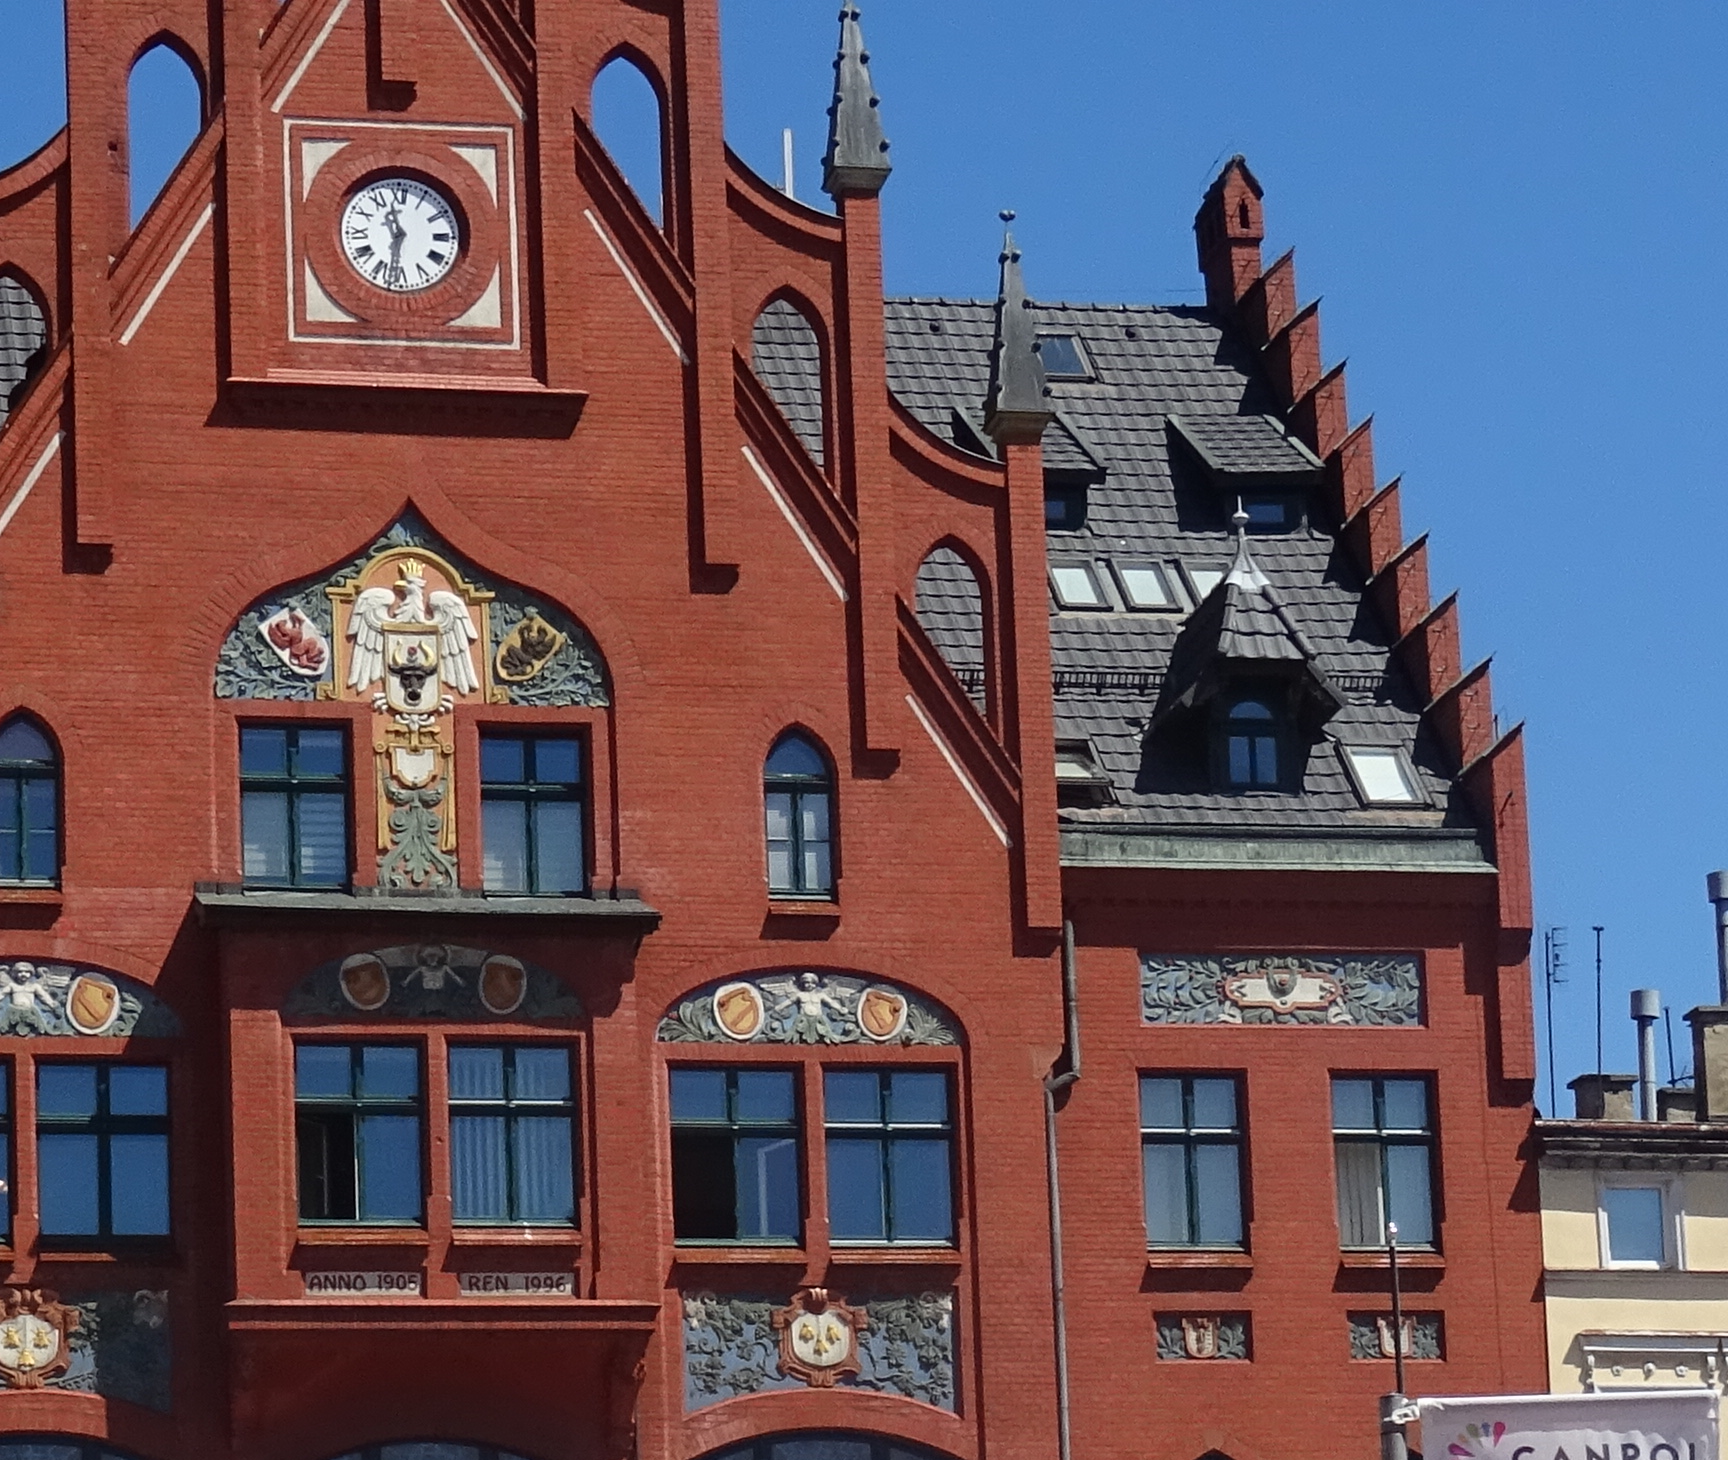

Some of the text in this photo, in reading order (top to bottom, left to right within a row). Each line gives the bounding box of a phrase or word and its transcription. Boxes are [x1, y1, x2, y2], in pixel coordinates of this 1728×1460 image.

[308, 1273, 419, 1292] ANNO 1905
[523, 1275, 567, 1293] 1996
